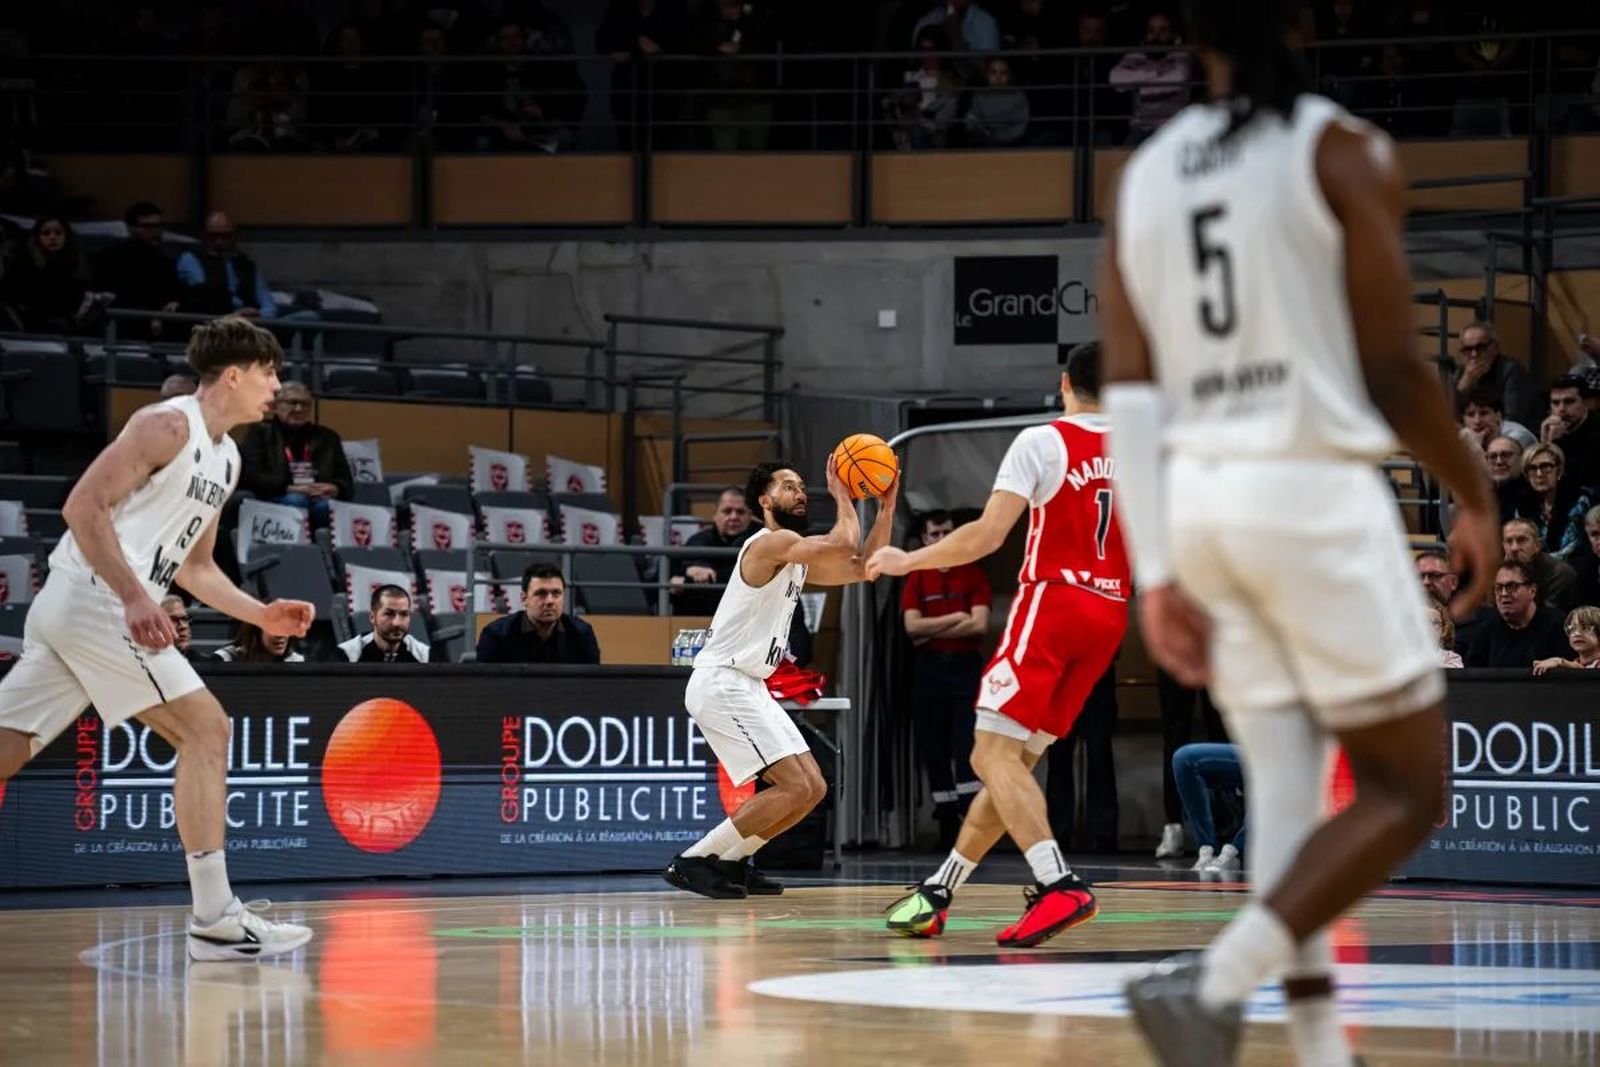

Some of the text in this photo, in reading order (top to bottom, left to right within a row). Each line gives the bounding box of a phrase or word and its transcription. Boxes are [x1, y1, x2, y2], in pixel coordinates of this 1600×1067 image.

[1189, 204, 1237, 339] 5
[955, 308, 972, 327] Le
[1066, 456, 1119, 491] NADO
[1094, 488, 1113, 560] 1
[102, 716, 310, 772] DOILLE
[524, 716, 706, 768] DODILLE
[75, 717, 97, 830] GROUPE
[501, 715, 521, 823] GROUPE
[100, 791, 309, 830] PUBCITE
[522, 786, 706, 823] PUBLICITE
[1452, 794, 1590, 832] PUBLIC
